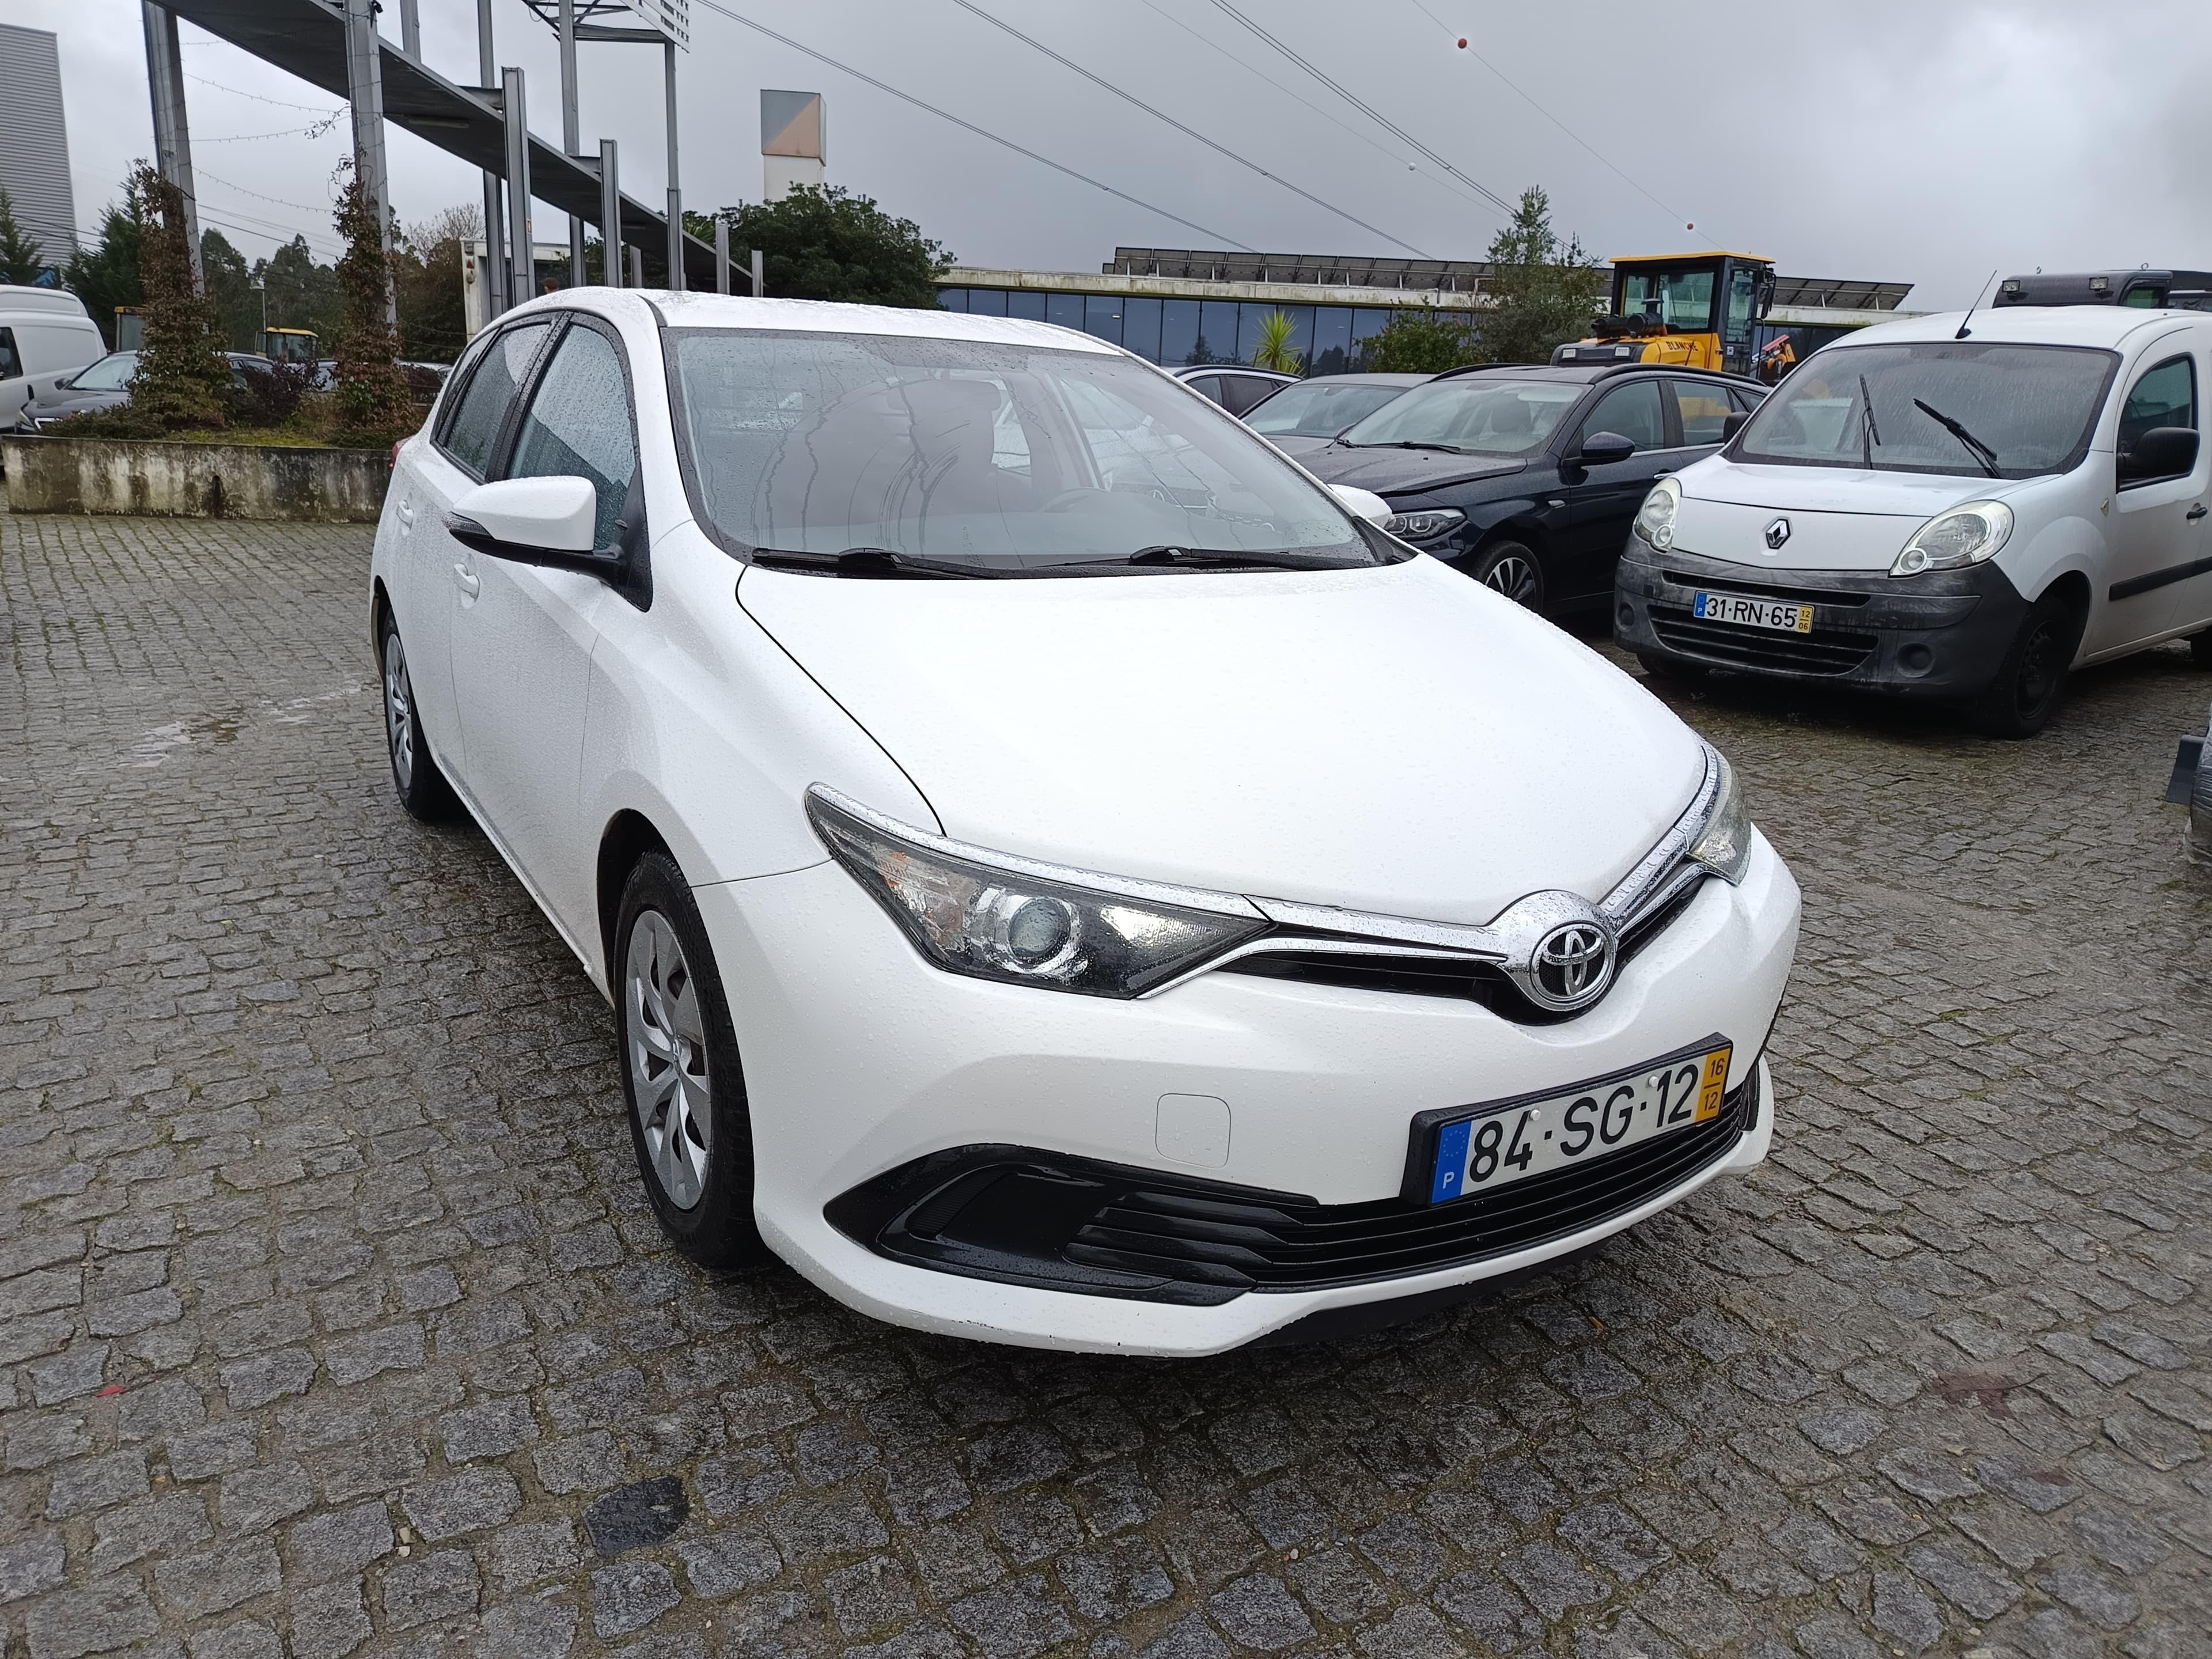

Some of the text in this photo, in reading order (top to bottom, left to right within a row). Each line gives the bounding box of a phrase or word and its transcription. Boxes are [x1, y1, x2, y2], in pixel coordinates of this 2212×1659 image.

[1801, 609, 1810, 618] 12
[1798, 622, 1808, 630] 06
[1710, 1058, 1725, 1078] 16
[1704, 1091, 1718, 1111] 12
[1442, 1171, 1455, 1190] P
